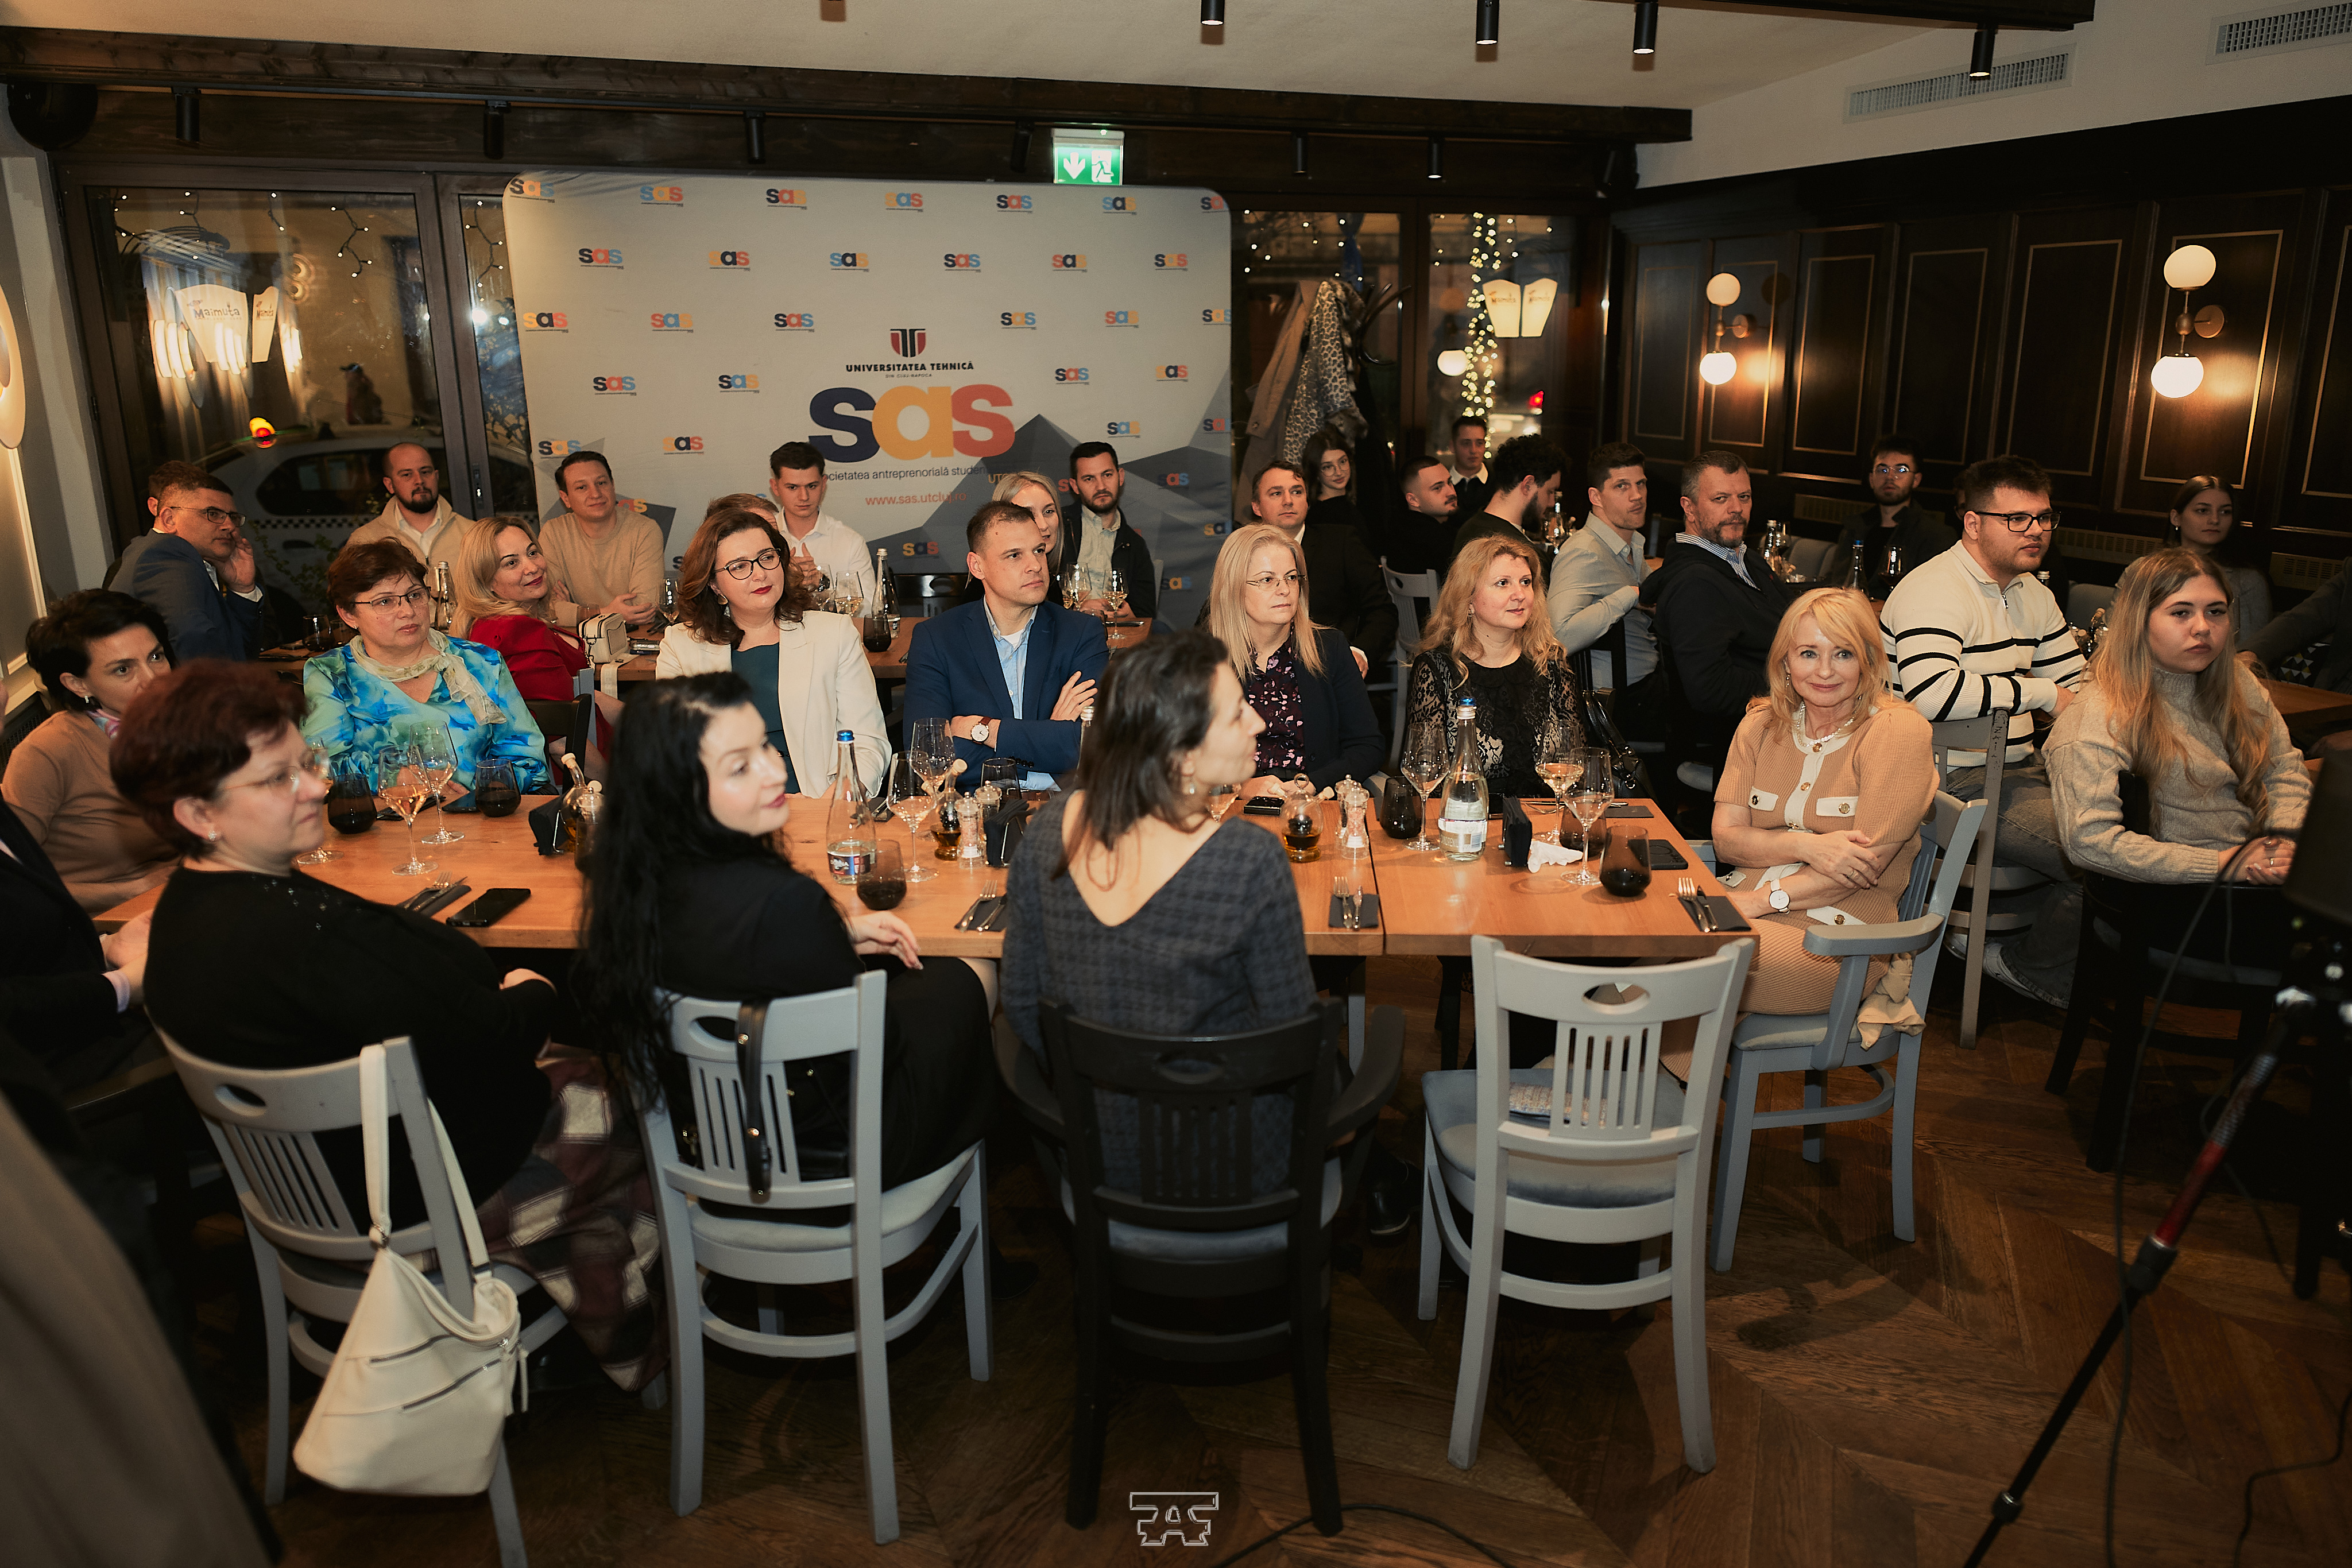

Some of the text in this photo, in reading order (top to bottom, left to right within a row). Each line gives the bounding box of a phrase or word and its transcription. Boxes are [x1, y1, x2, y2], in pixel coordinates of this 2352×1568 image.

[510, 179, 554, 198] sas
[640, 186, 683, 202] sas
[766, 188, 806, 204] sas
[885, 193, 923, 207] sas
[997, 195, 1032, 209] sas
[1103, 197, 1136, 211] sas
[1201, 196, 1229, 210] sa
[579, 248, 622, 264] sas
[709, 251, 749, 266] sas
[830, 253, 868, 268] sas
[944, 254, 980, 268] sas
[1053, 254, 1086, 268] sas
[1155, 254, 1187, 268] sas
[523, 312, 567, 328] sas
[651, 313, 693, 328] sas
[774, 313, 814, 328] sas
[1001, 312, 1036, 326] sas
[1105, 311, 1139, 324] sas
[846, 361, 974, 372] UNIVERSITATEA TEHNICĂ
[1055, 367, 1089, 381] sas
[1156, 365, 1187, 378] sas
[593, 376, 636, 392] sas
[718, 374, 759, 389] sas
[808, 384, 1015, 463] sas
[1107, 421, 1140, 435] sas
[539, 440, 581, 455] sas
[663, 436, 703, 451] sas
[872, 467, 949, 480] antreprenorială
[616, 498, 647, 513] as
[865, 491, 966, 506] www.sas.utcluj.ro
[903, 541, 939, 556] sas
